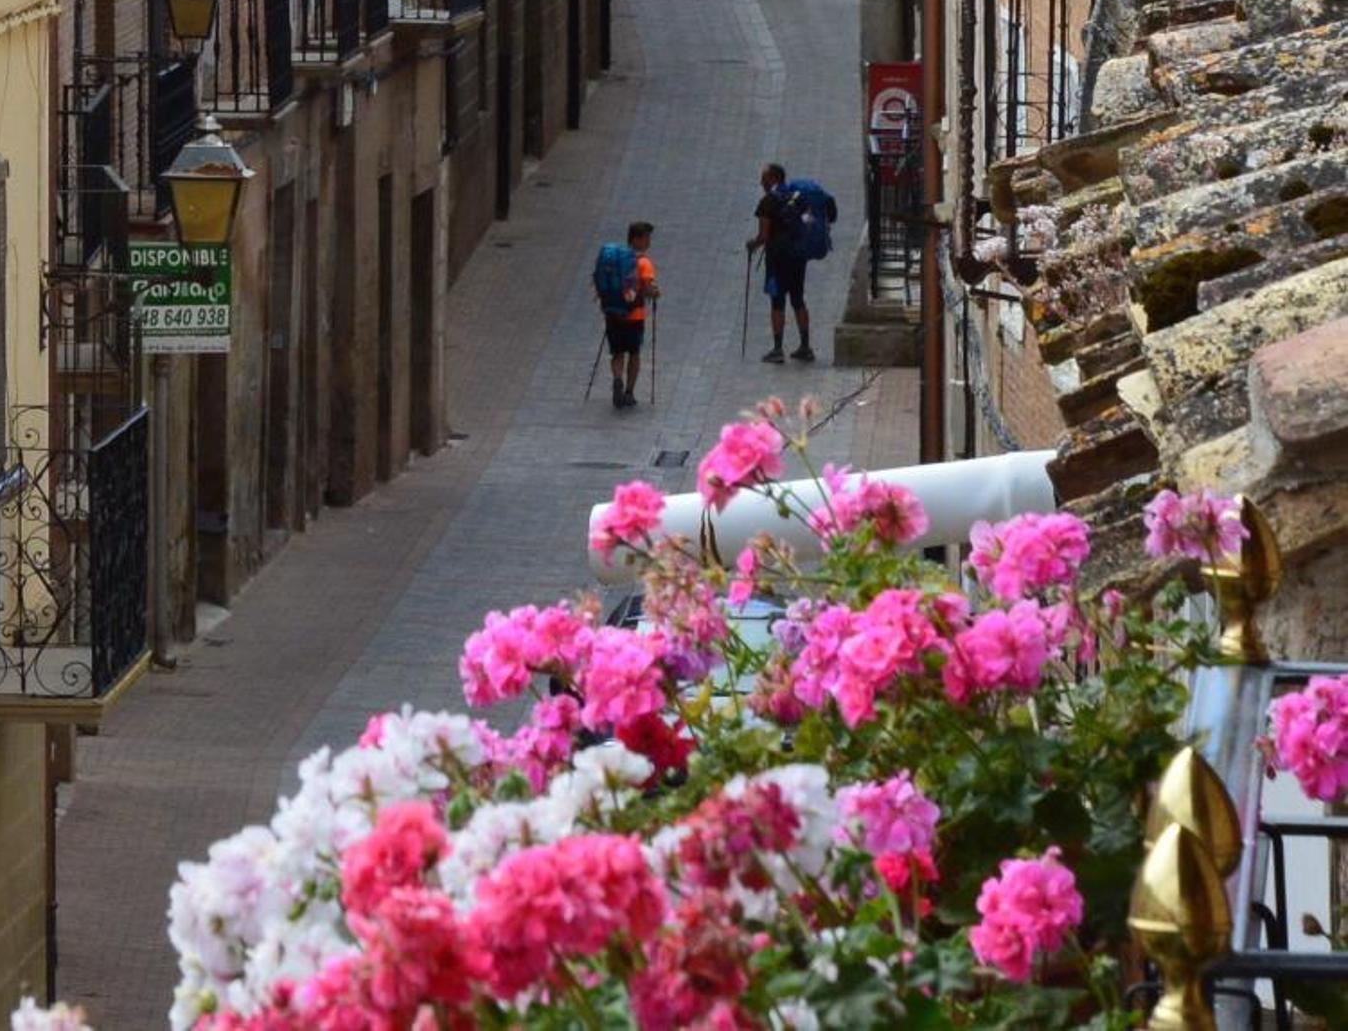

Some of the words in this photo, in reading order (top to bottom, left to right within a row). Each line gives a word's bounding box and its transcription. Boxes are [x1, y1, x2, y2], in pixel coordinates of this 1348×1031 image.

[130, 249, 228, 266] DISPONIBLE
[164, 309, 193, 326] 640
[197, 308, 226, 326] 938
